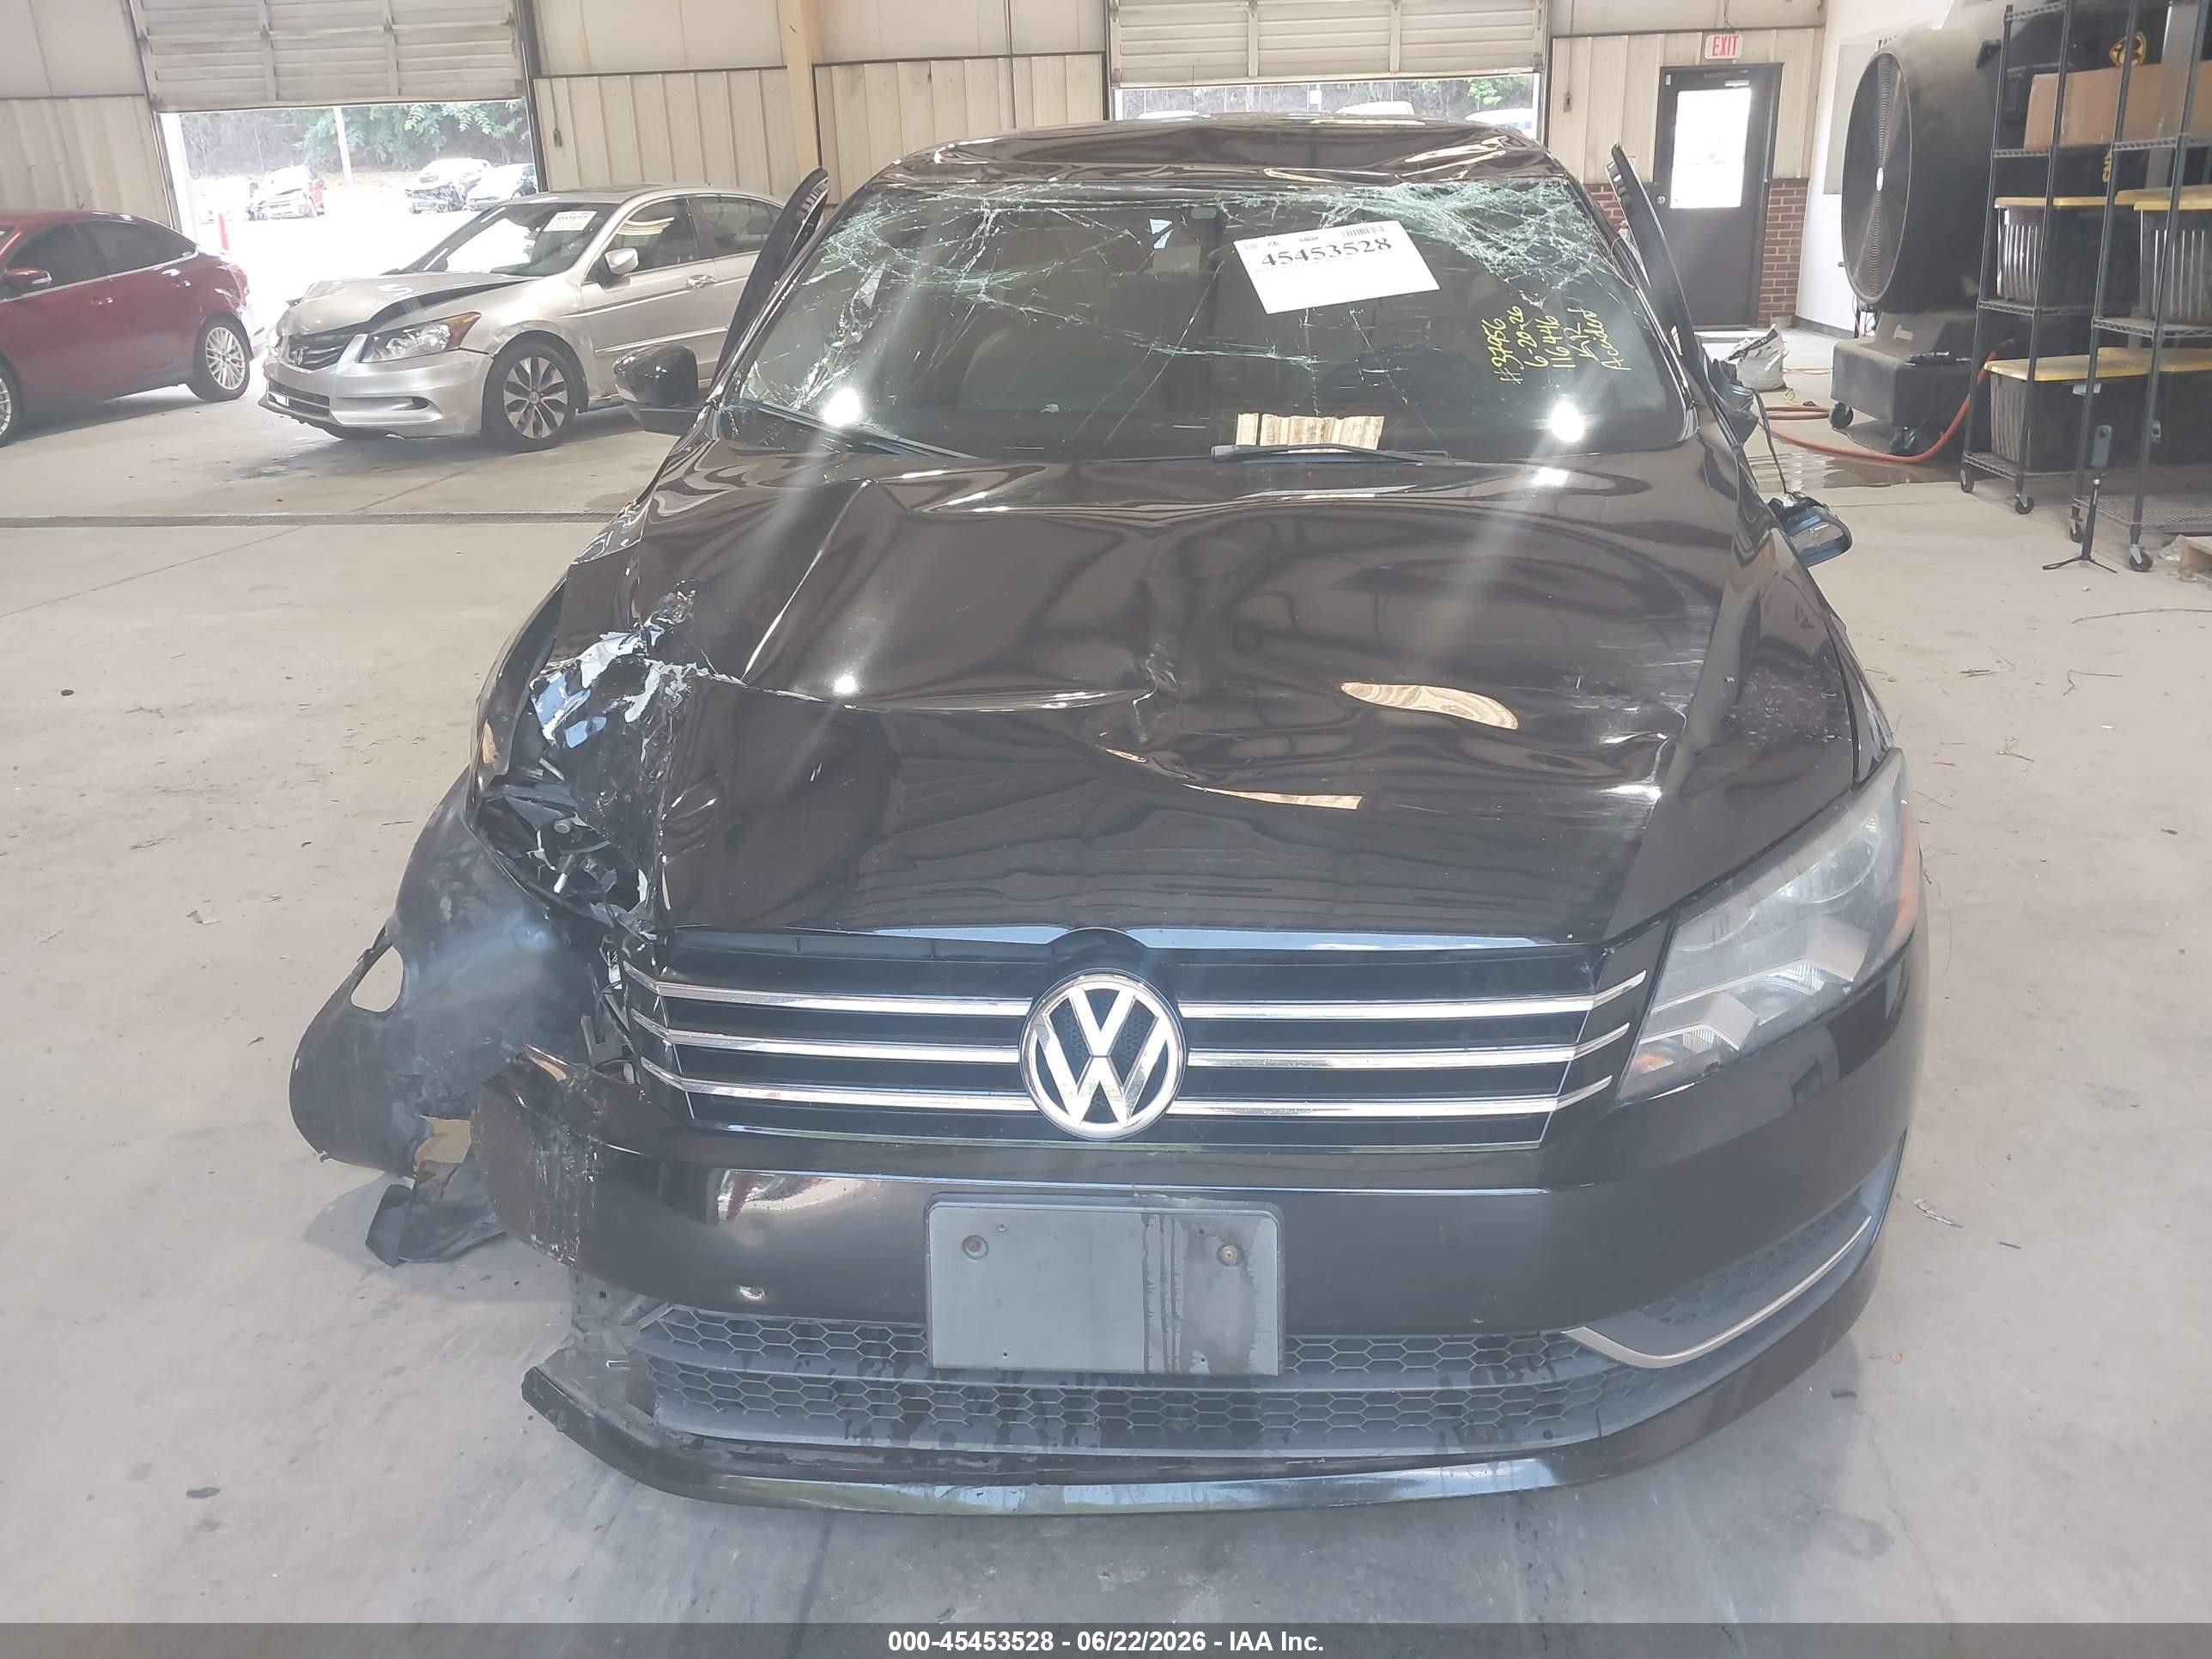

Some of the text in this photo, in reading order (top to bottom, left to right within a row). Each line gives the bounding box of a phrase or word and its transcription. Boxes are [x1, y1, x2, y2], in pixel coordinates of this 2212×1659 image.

[1711, 35, 1739, 56] EXIT
[1261, 236, 1393, 266] 45453528
[1480, 317, 1525, 385] #37956
[1506, 305, 1549, 368] 6-20-26
[1566, 306, 1632, 370] Accident
[1024, 975, 1180, 1135] VW
